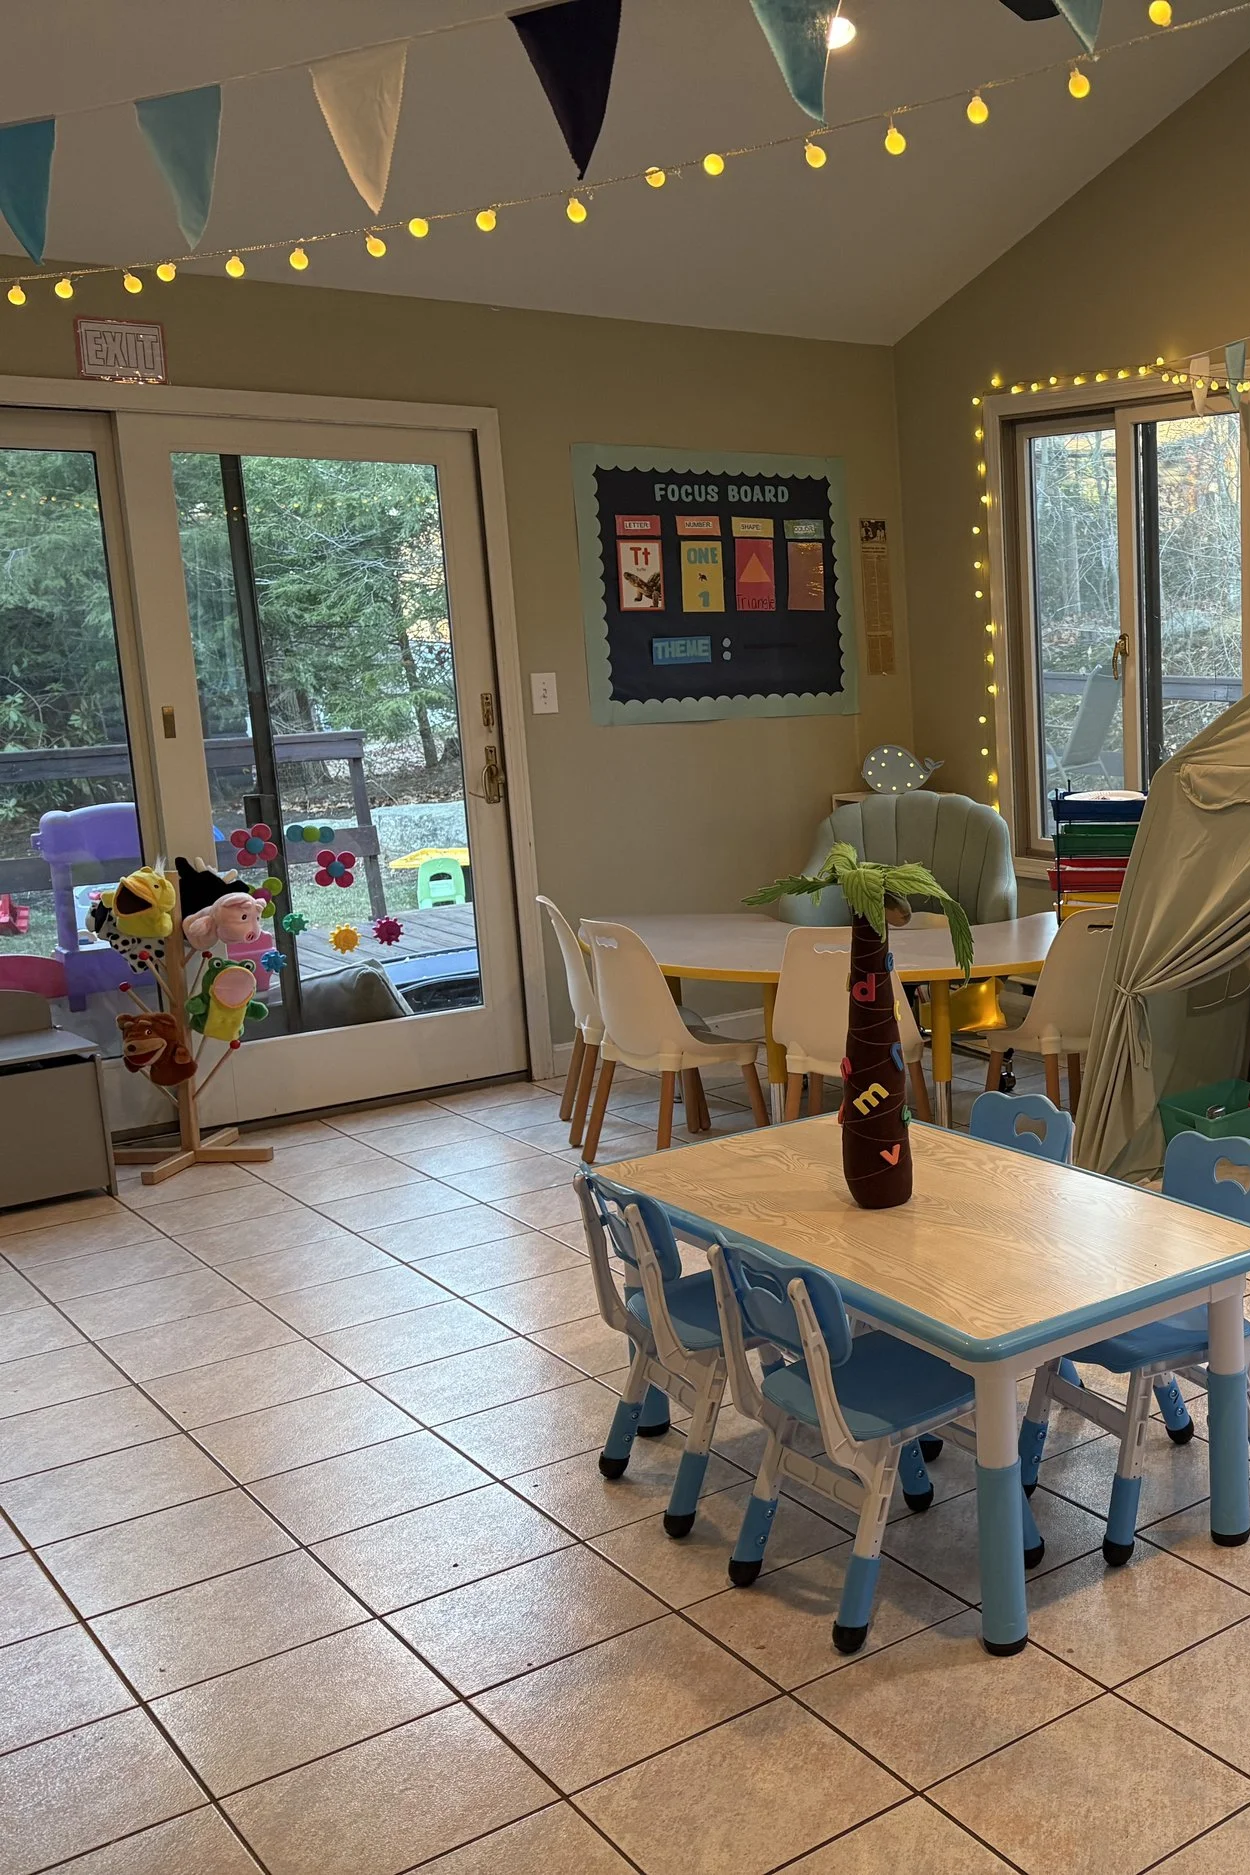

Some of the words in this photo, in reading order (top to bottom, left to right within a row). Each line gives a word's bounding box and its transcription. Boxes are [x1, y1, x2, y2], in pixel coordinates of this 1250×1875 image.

[85, 329, 158, 370] EXIT
[654, 483, 719, 502] FOCUS
[727, 484, 789, 503] BOARD
[629, 546, 651, 566] Tt
[686, 547, 719, 565] ONE
[697, 591, 710, 608] 1
[736, 594, 775, 610] Triangle
[654, 640, 709, 660] THEME
[852, 973, 876, 1002] d
[852, 1082, 890, 1116] m
[880, 1144, 901, 1166] v
